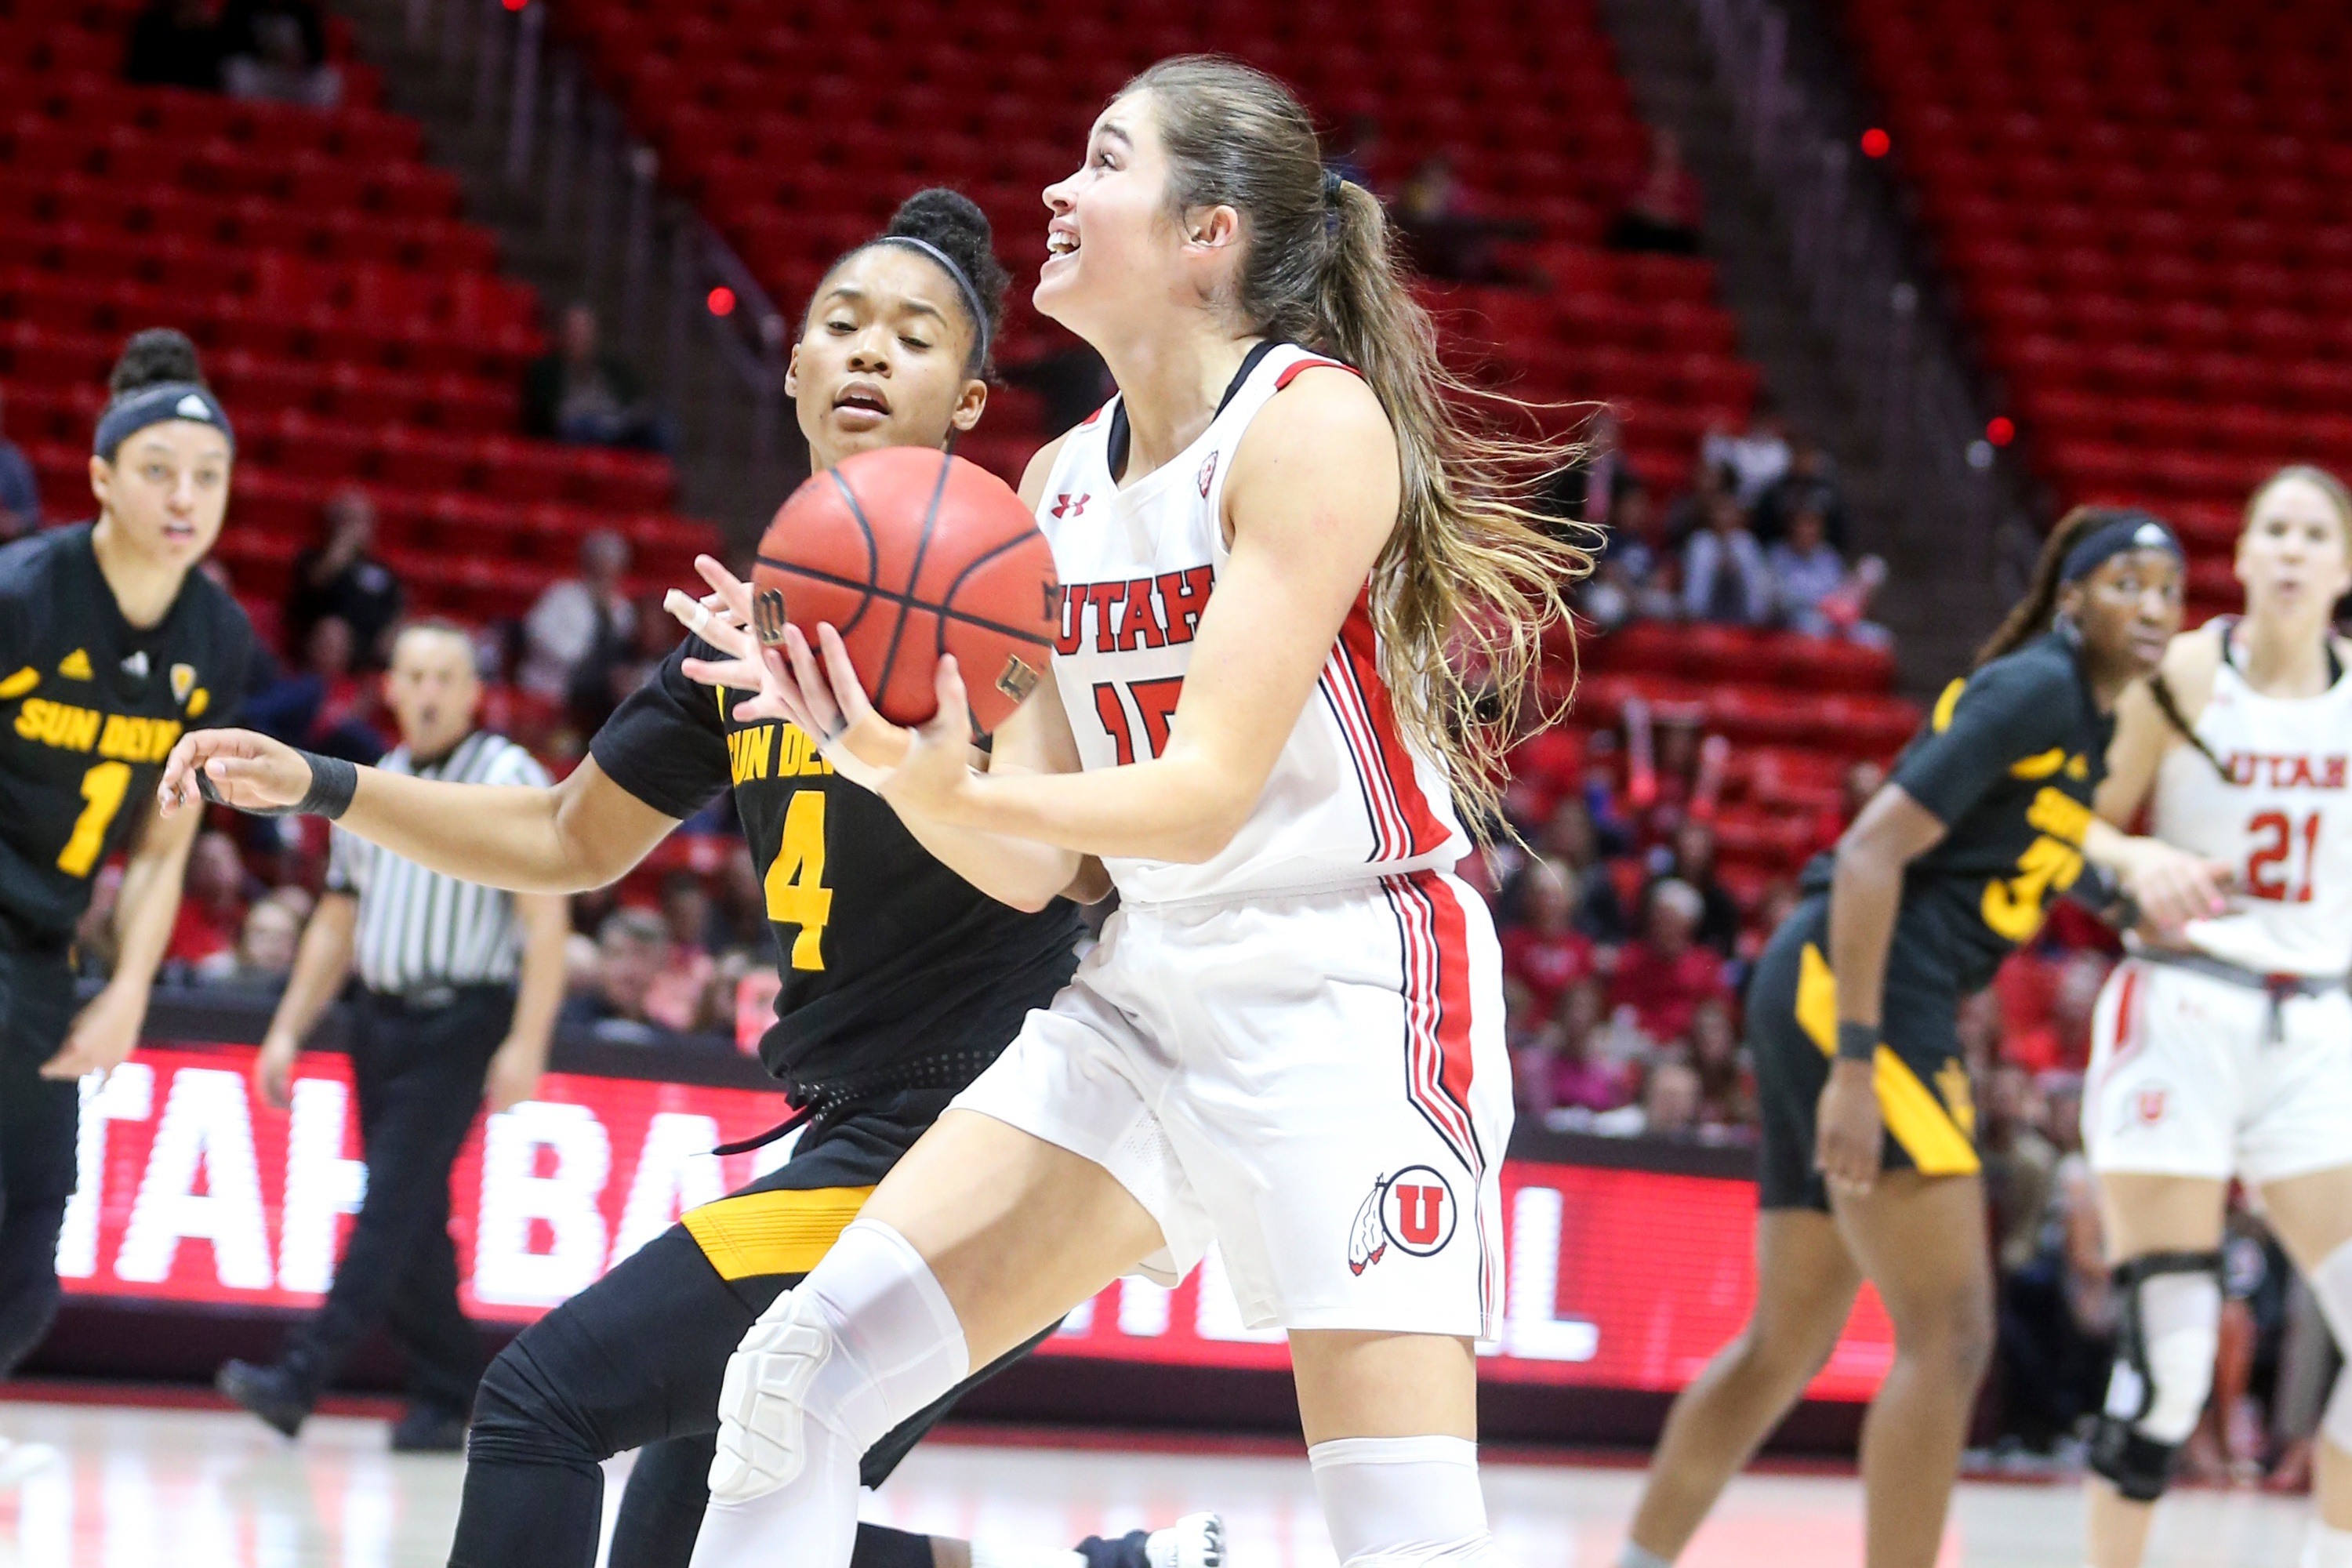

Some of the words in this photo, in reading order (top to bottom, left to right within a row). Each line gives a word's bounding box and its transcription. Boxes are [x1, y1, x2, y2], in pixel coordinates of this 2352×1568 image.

[1054, 564, 1214, 655] UTAH
[14, 697, 101, 753] SUN
[2228, 752, 2347, 789] UTAH
[56, 760, 132, 879] 1
[2248, 811, 2320, 902] 21
[764, 789, 833, 970] 4
[1396, 1184, 1444, 1245] U
